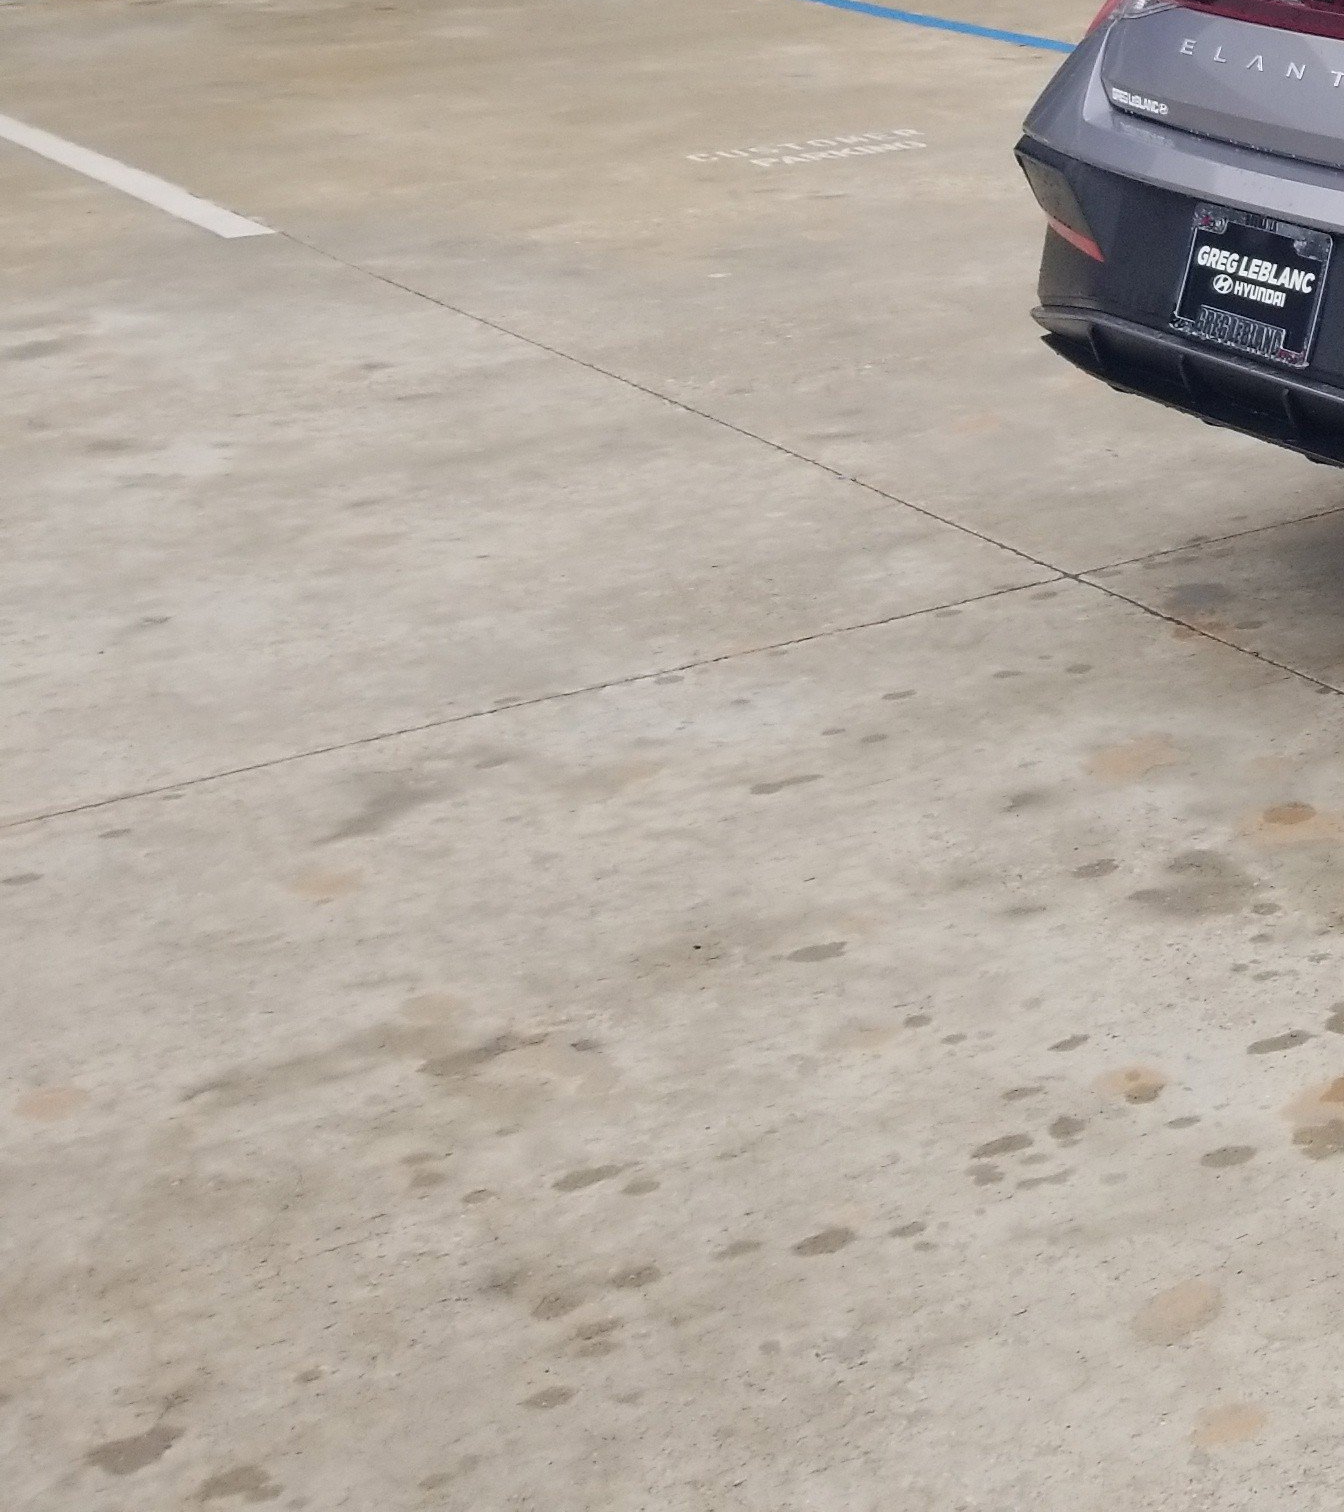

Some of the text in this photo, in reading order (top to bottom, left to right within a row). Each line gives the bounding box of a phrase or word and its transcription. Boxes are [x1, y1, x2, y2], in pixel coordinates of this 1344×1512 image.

[1197, 245, 1316, 294] GREG LEBLANC
[1233, 280, 1287, 308] HYUNDAI
